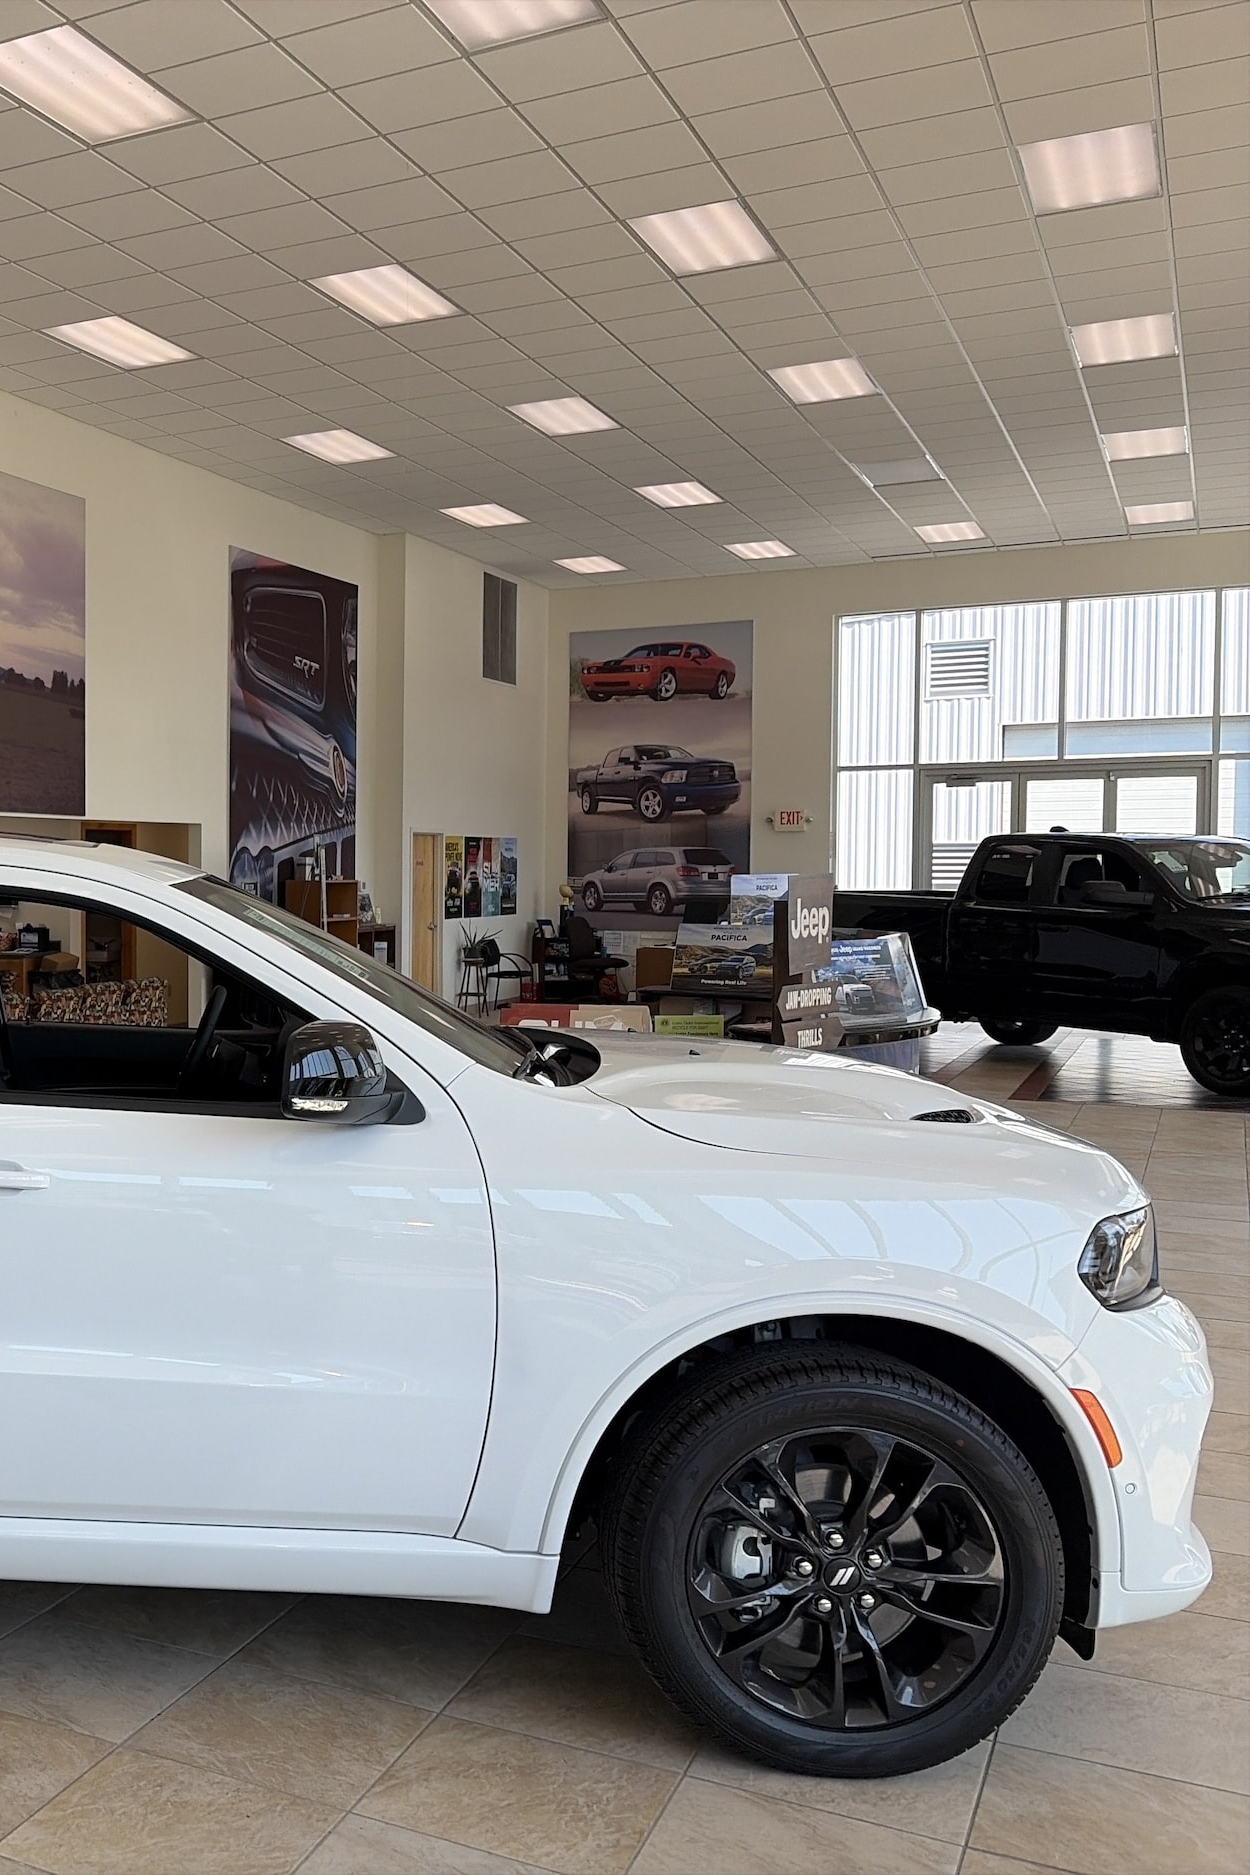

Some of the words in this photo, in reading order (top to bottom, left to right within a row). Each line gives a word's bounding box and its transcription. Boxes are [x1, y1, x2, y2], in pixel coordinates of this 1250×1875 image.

[292, 655, 320, 679] SRT
[780, 811, 801, 825] EXIT
[755, 884, 778, 892] PACIFICA
[791, 897, 830, 944] Jeep
[710, 934, 748, 942] PACIFICA
[786, 987, 832, 1010] JAW-DROPPING
[797, 1028, 823, 1048] THRILLS
